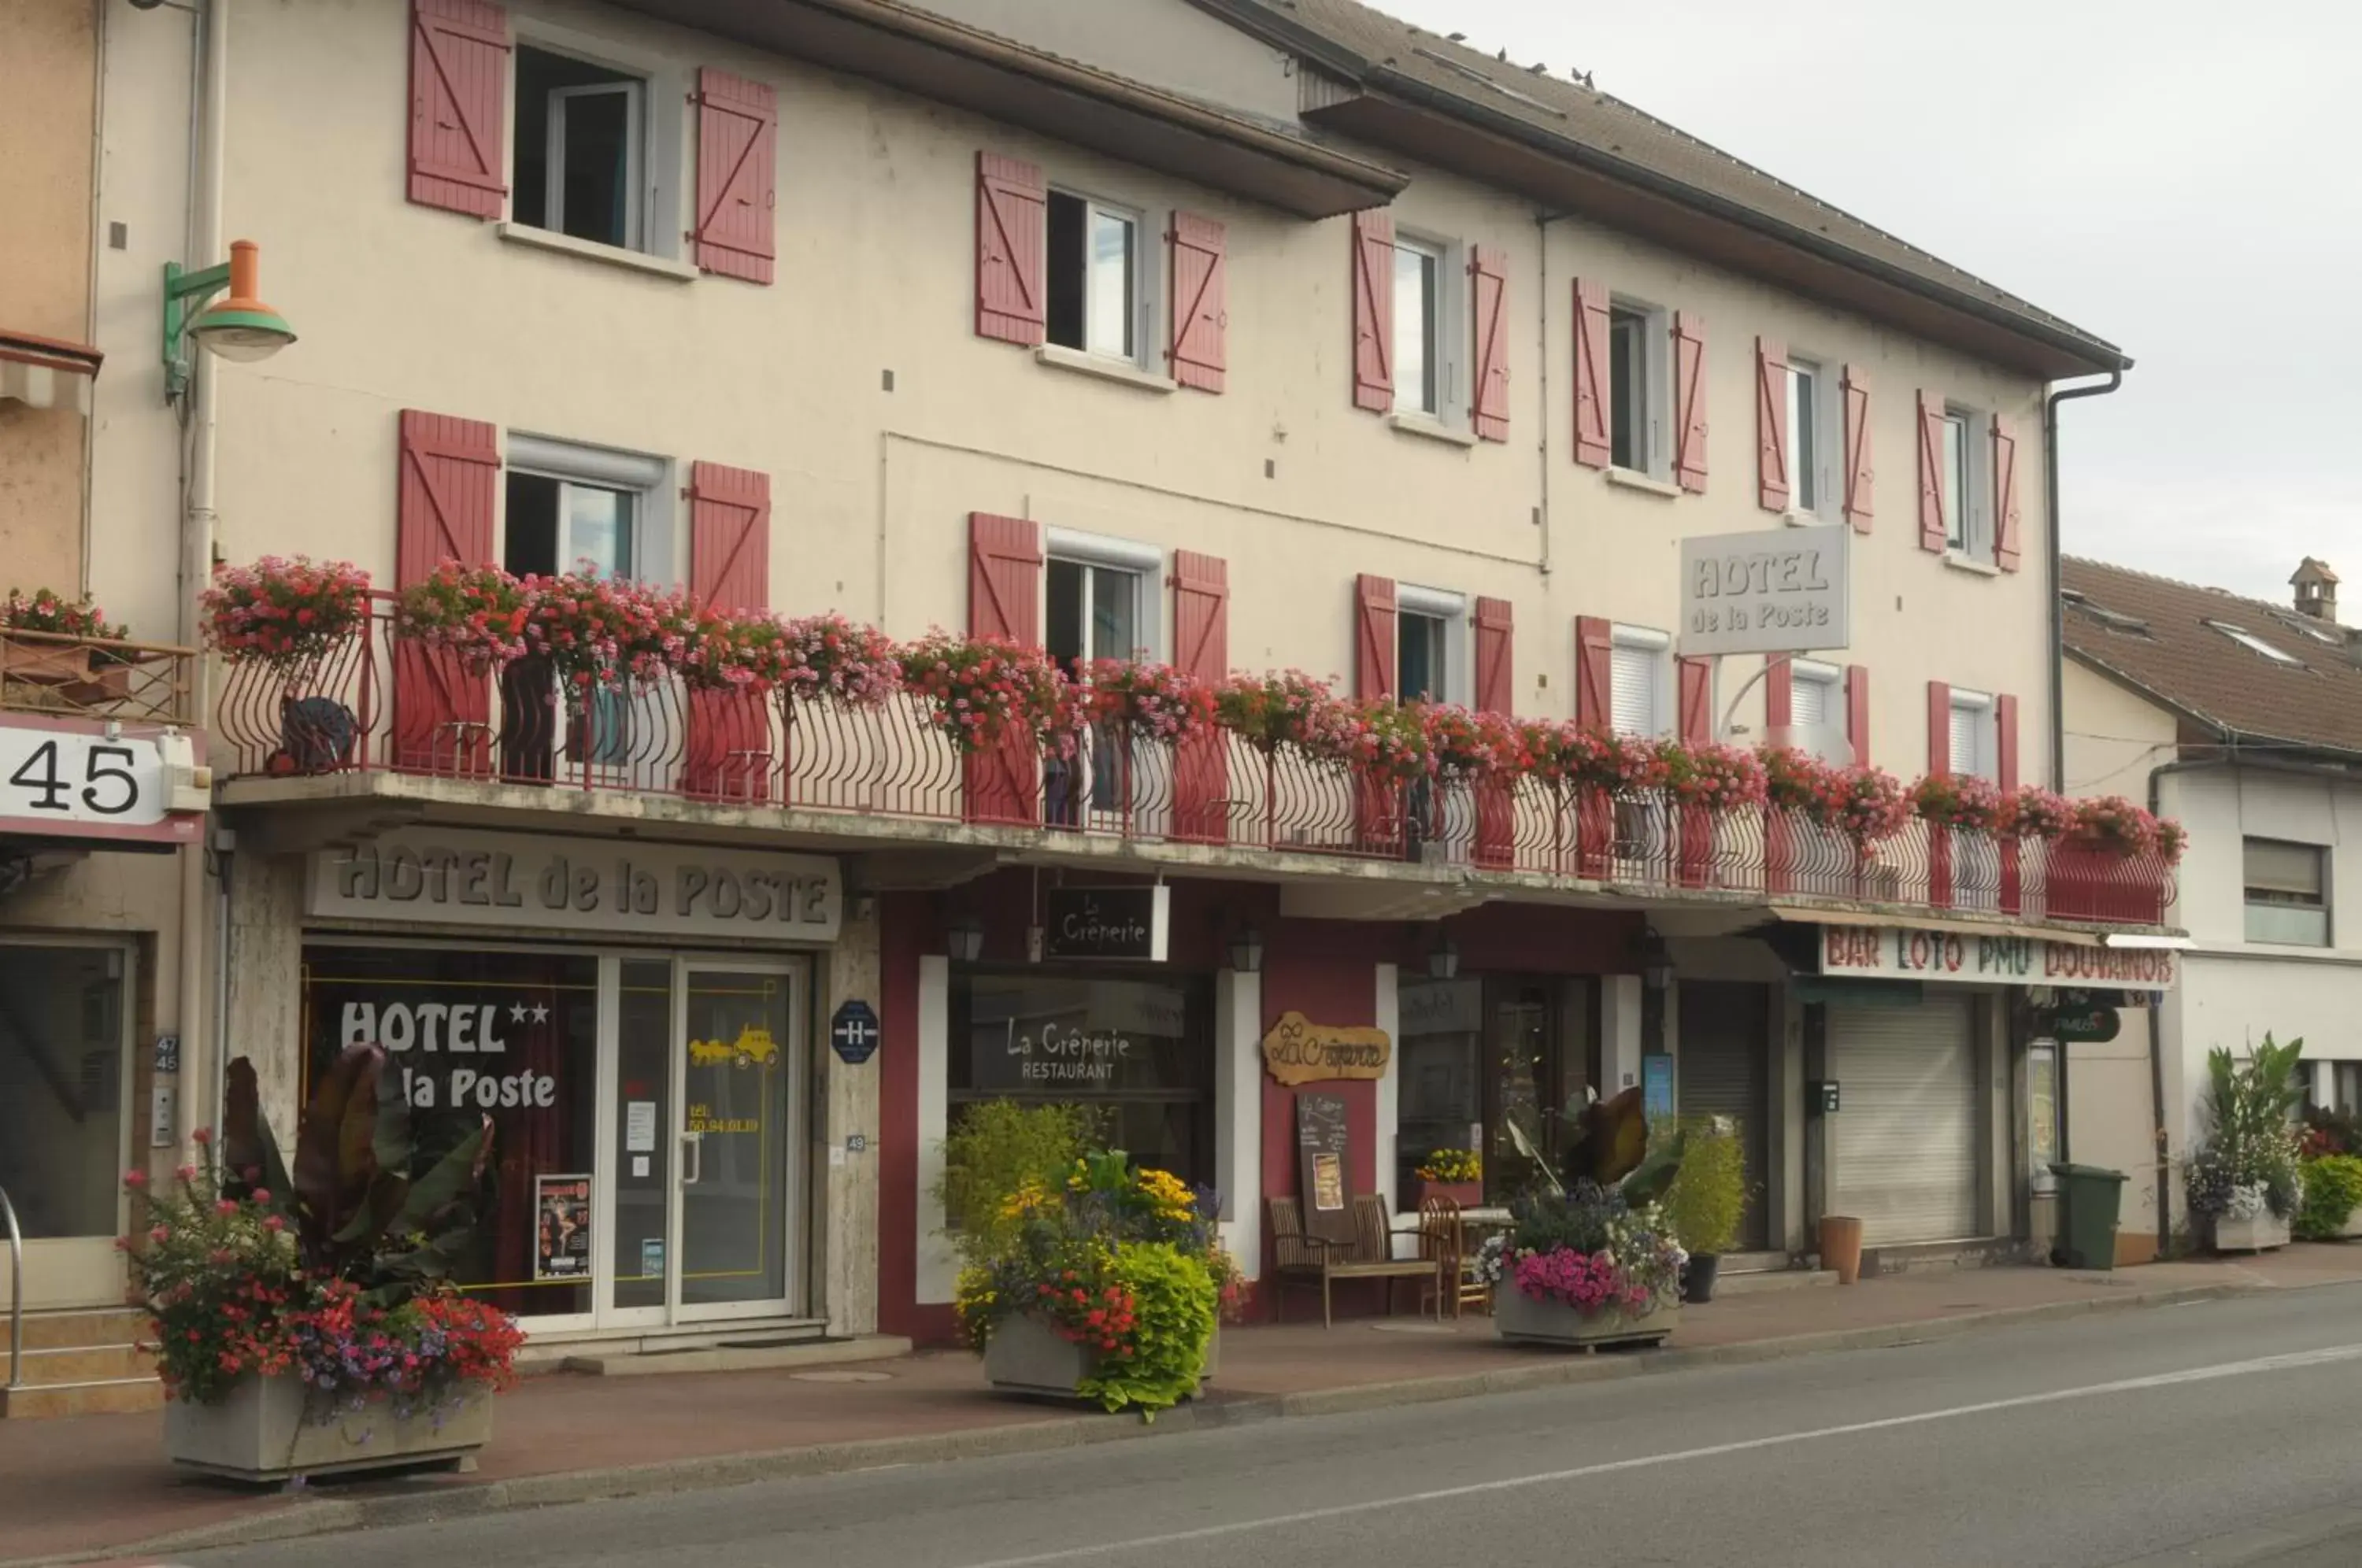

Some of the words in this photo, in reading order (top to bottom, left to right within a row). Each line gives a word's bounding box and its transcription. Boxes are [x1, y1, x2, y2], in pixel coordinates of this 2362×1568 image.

[1694, 550, 1829, 598] HOTEL
[1693, 607, 1719, 634] de
[1727, 606, 1748, 631] la
[1757, 602, 1830, 630] Poste
[9, 740, 139, 815] 45
[339, 844, 523, 908] HOTEL
[539, 854, 598, 912] de
[616, 858, 658, 915] la
[676, 864, 827, 924] POSTE
[1827, 926, 1880, 968] BAR
[1897, 929, 1965, 971] LOTO
[1979, 934, 2030, 976] PMU
[341, 1002, 506, 1052] HOTEL
[1007, 1017, 1031, 1055] La
[1042, 1023, 1131, 1062] Crêperie
[157, 1056, 177, 1070] 45
[1023, 1063, 1115, 1080] RESTAURANT
[402, 1067, 435, 1108] la
[451, 1068, 555, 1108] Poste
